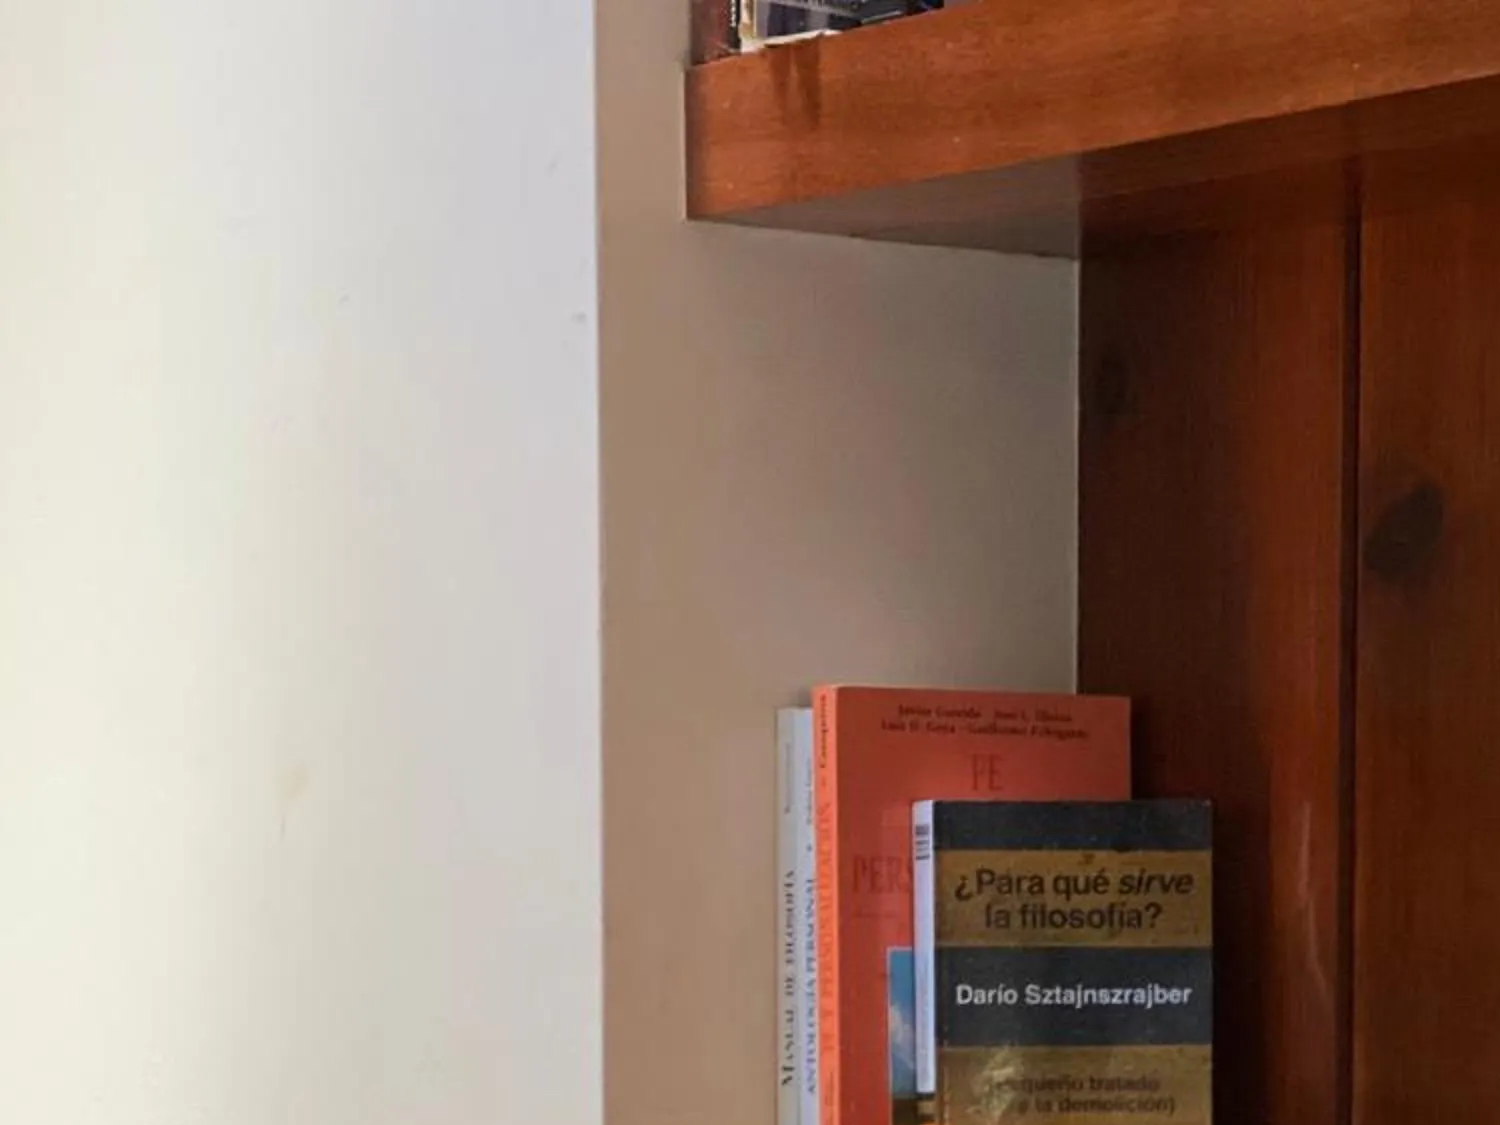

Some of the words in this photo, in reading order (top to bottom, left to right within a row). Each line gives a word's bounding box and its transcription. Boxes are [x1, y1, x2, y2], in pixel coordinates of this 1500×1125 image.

[852, 853, 911, 895] PER
[954, 867, 1045, 901] ¿Para
[1052, 867, 1111, 901] qué
[1118, 867, 1195, 895] sirve
[985, 902, 1011, 929] la
[955, 983, 1019, 1006] Darío
[1024, 982, 1193, 1010] Sztajnszrajber
